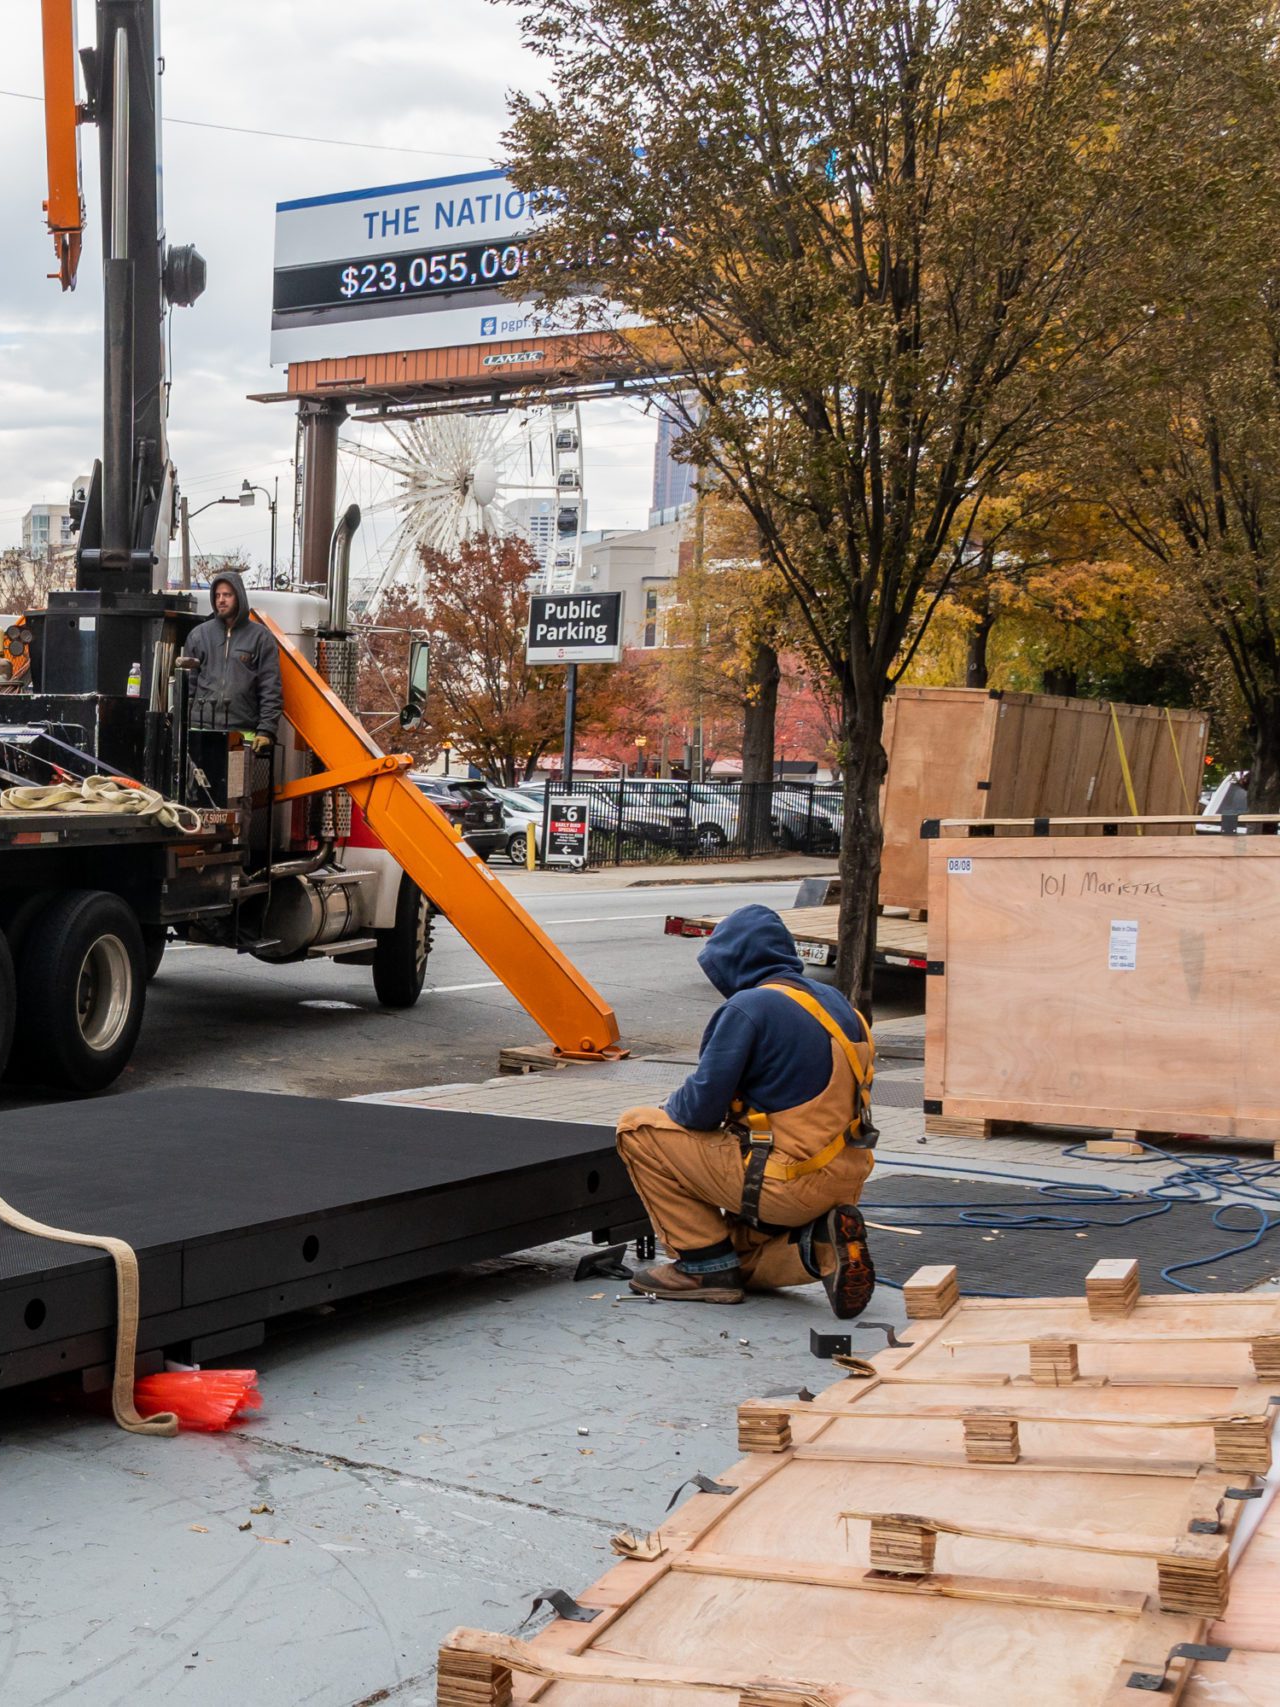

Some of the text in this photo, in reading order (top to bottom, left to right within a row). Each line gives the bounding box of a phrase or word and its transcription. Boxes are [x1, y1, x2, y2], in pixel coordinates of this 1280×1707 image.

[364, 206, 420, 239] THE
[545, 600, 601, 620] Public
[536, 622, 608, 643] Parking
[949, 860, 971, 871] 08/08
[1040, 872, 1066, 898] 101
